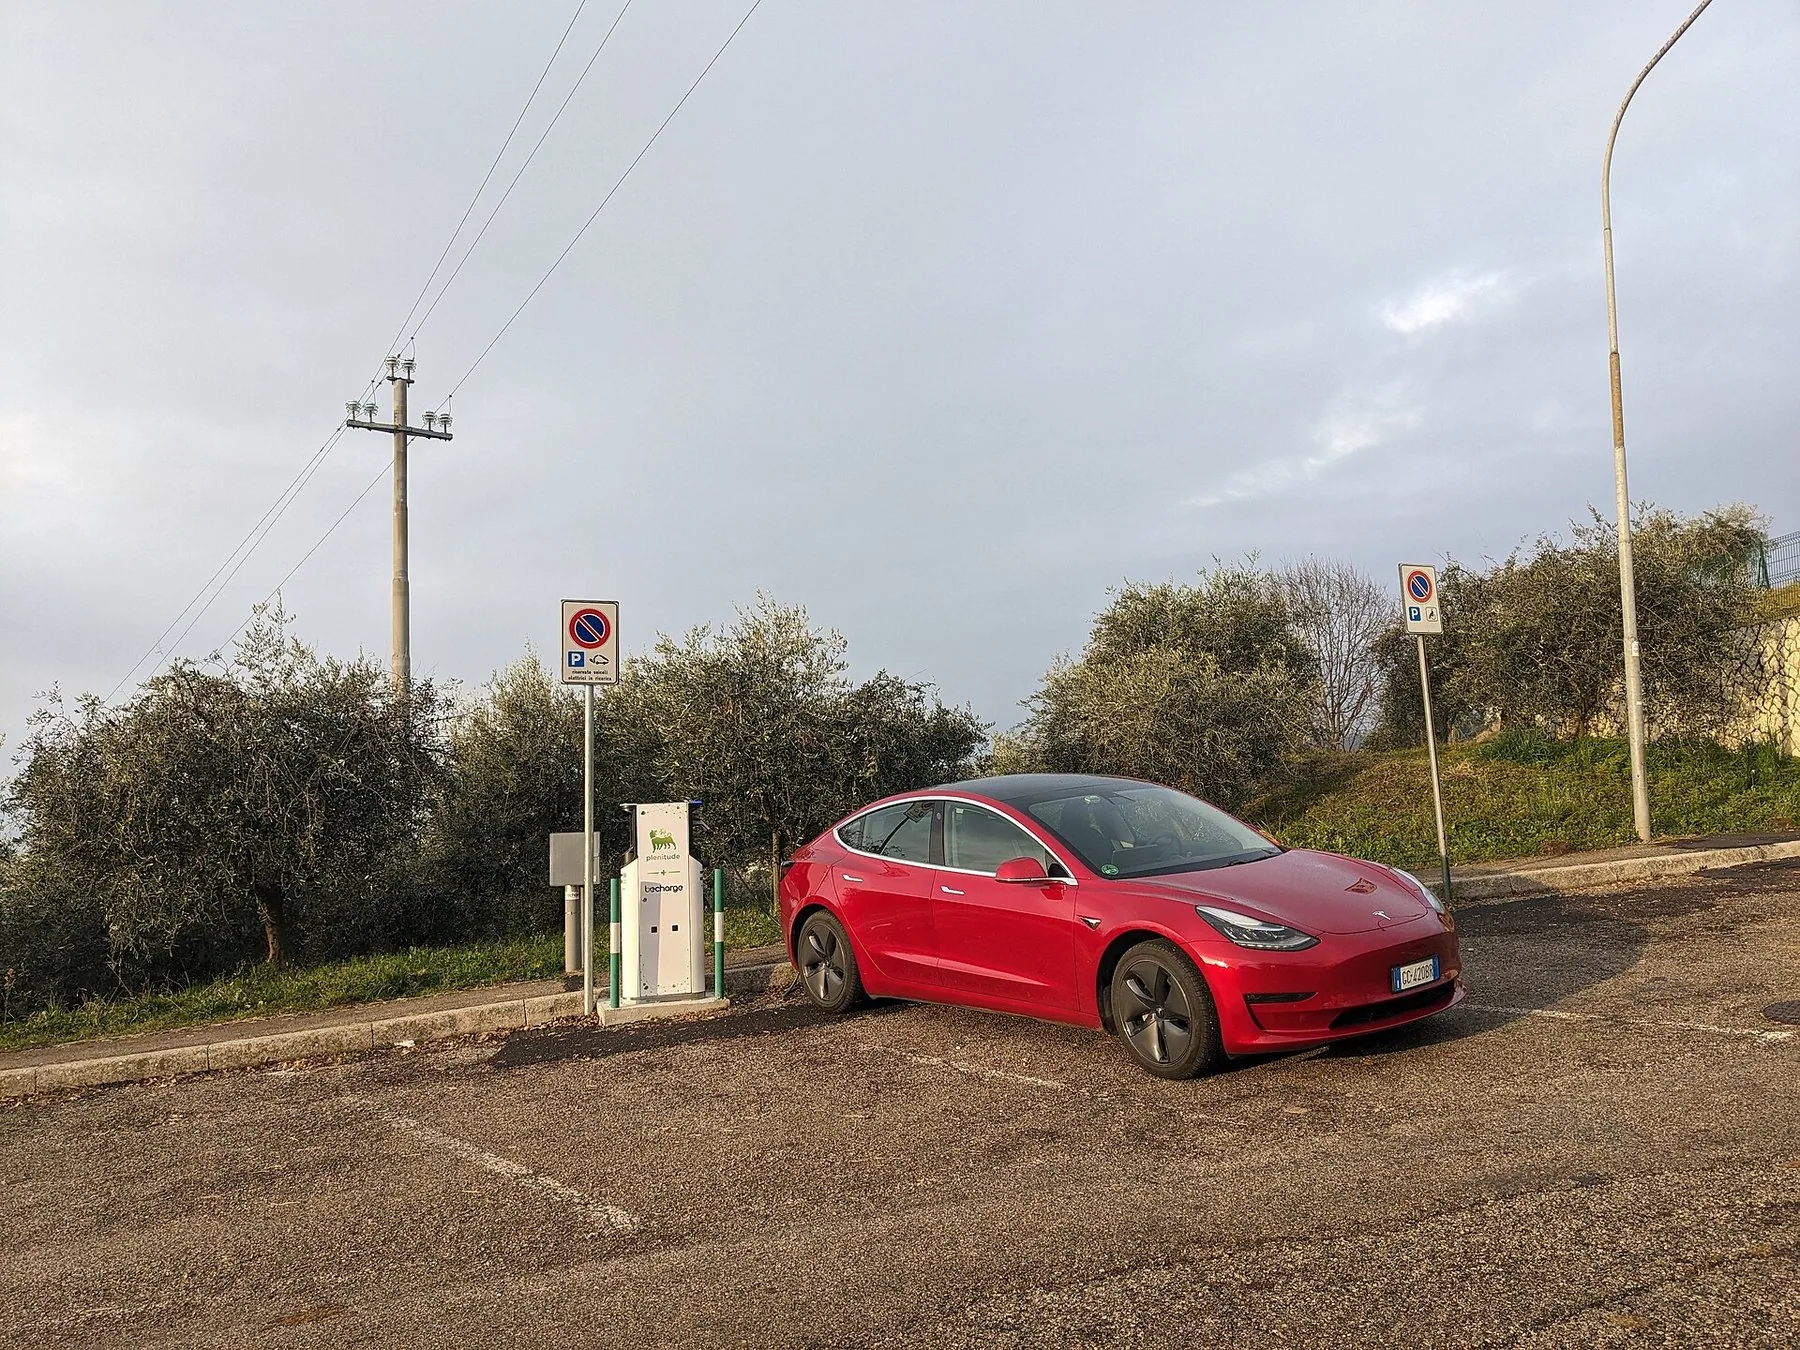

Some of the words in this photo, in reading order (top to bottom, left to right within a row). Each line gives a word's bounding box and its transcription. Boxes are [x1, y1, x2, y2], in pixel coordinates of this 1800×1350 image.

[1411, 608, 1419, 620] P
[571, 653, 582, 666] P
[646, 853, 681, 862] plenitude
